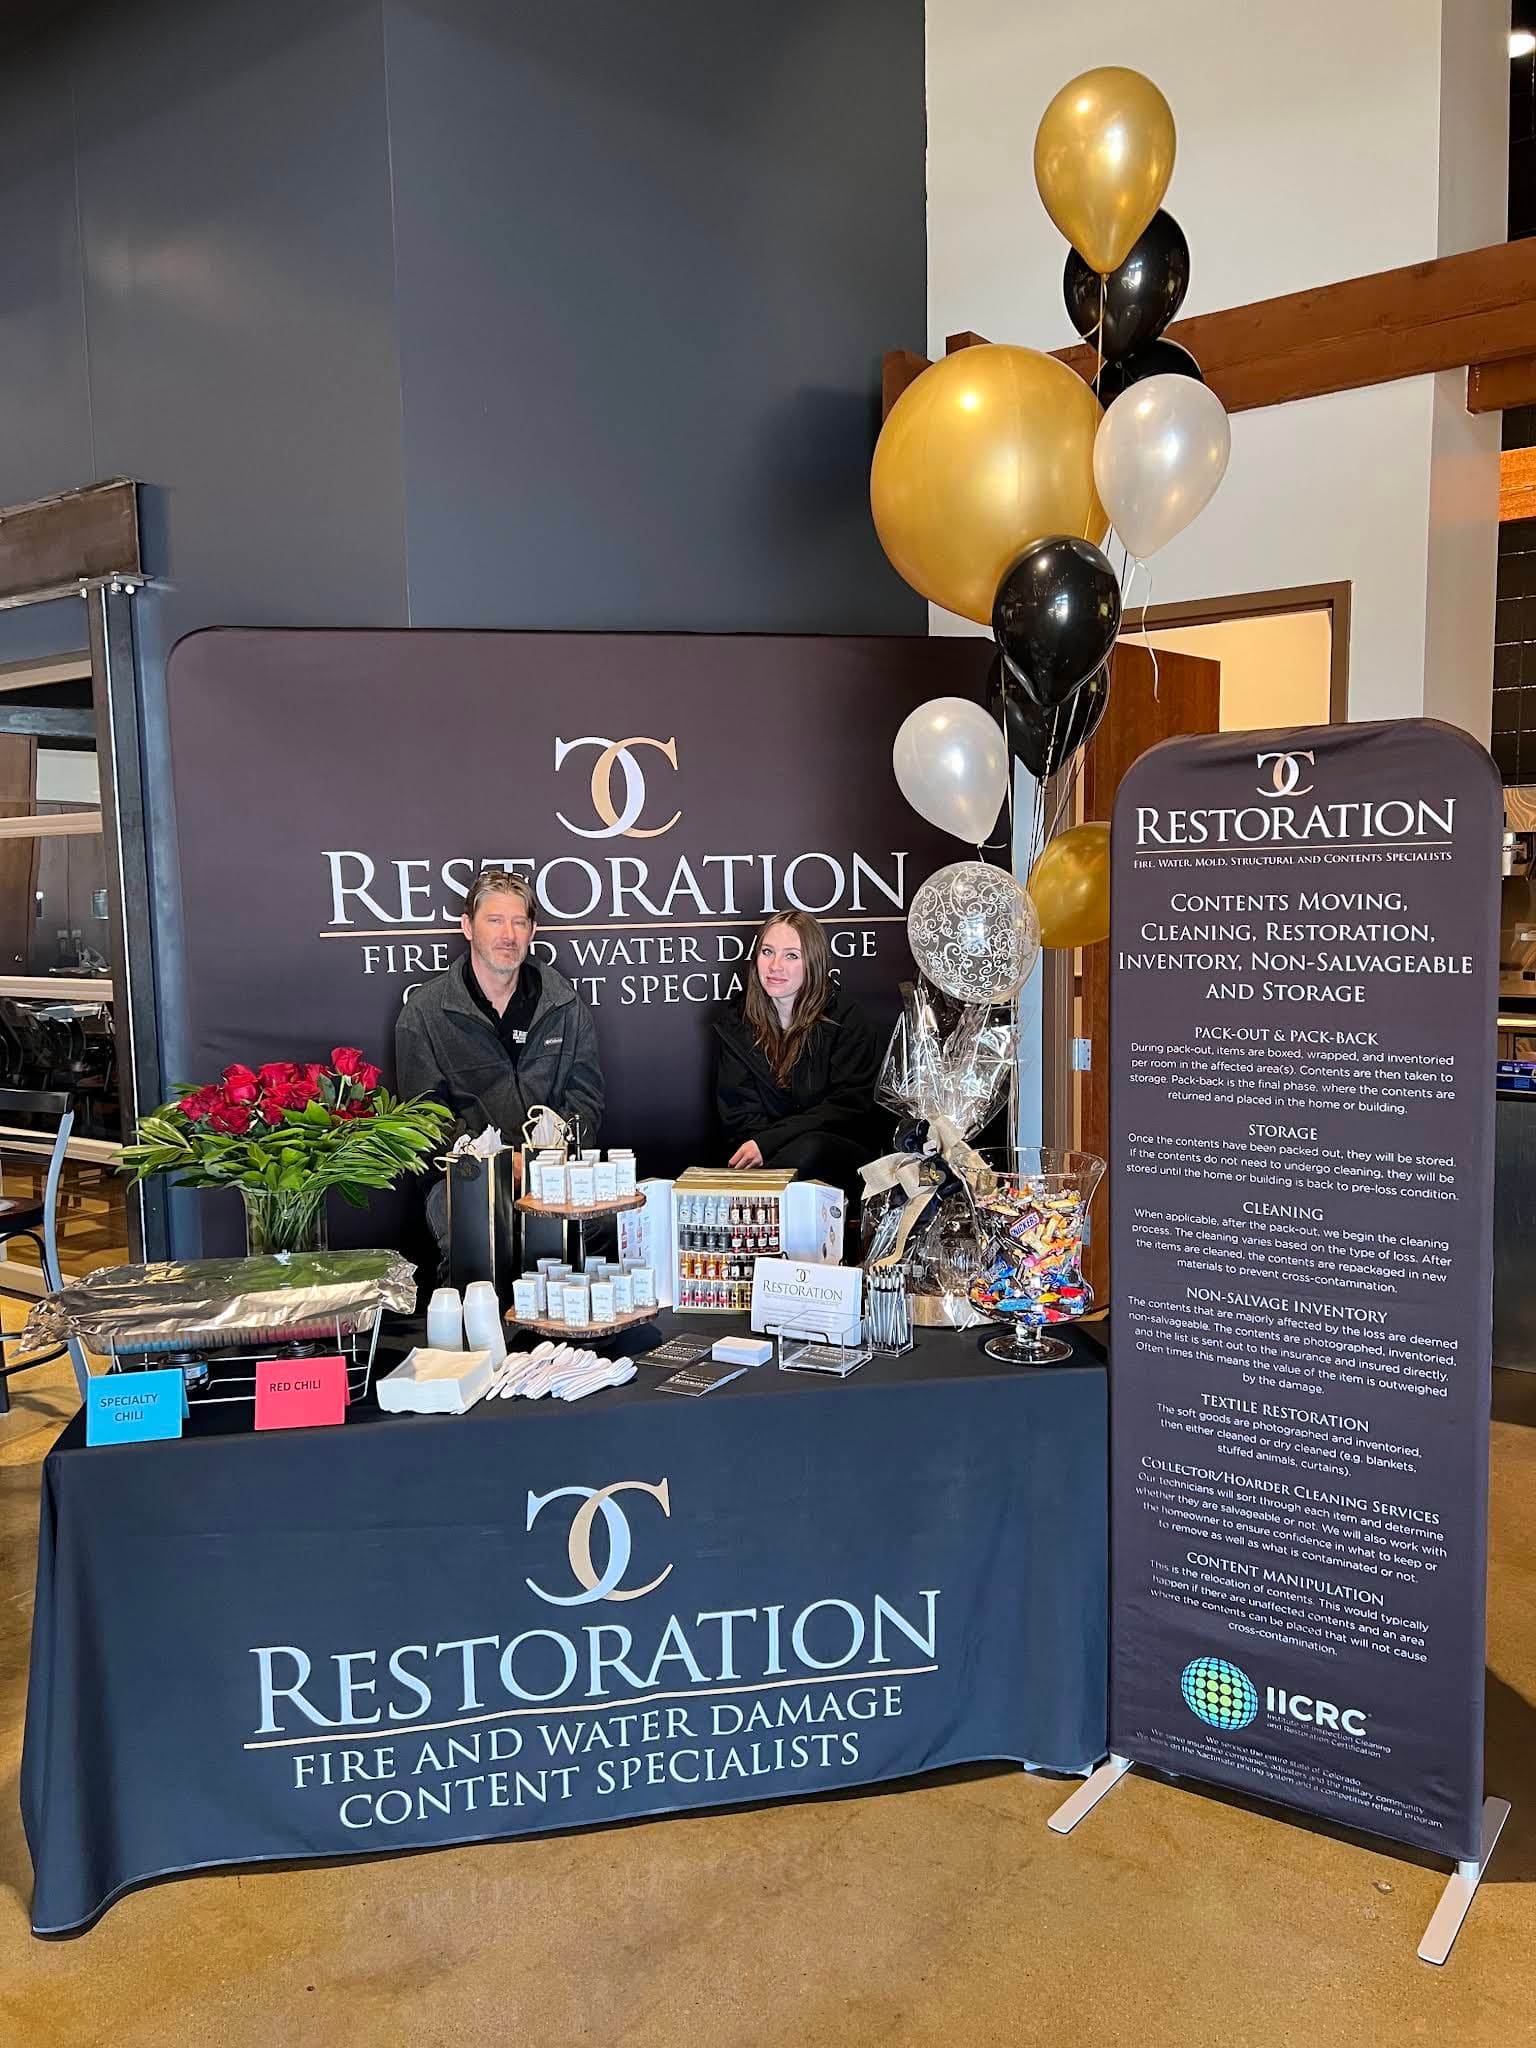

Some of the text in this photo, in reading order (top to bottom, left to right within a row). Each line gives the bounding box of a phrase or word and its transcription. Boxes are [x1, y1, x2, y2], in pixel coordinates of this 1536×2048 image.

[1136, 798, 1456, 845] RESTORATION
[1231, 856, 1294, 866] STRUCTURAL
[1298, 855, 1321, 864] AND
[1324, 853, 1383, 863] CONTENTS
[1386, 851, 1453, 862] SPECIALISTS
[1170, 892, 1409, 913] CONTENTS MOVING,
[1141, 922, 1435, 944] CLEANING, RESTORATION,
[361, 943, 450, 974] FIRE
[568, 936, 705, 966] WATER
[717, 931, 877, 962] DGE
[1118, 951, 1474, 975] INVENTORY, NON-SALVAGEABLE
[620, 968, 841, 1005] SPECIAS
[1205, 982, 1366, 1003] AND STORAGE
[1195, 1027, 1379, 1045] PACK-OUT & PACK-BACK
[1131, 1043, 1164, 1054] During
[1217, 1047, 1245, 1056] items
[1362, 1053, 1384, 1062] and
[1388, 1053, 1455, 1065] inventoried
[1171, 1075, 1224, 1087] Pack-back
[1227, 1079, 1235, 1087] is
[1238, 1079, 1255, 1088] the
[1258, 1080, 1281, 1089] final
[1322, 1083, 1357, 1094] where
[1359, 1085, 1379, 1095] the
[1381, 1087, 1433, 1098] contents
[1436, 1091, 1455, 1100] are
[1168, 1091, 1211, 1101] returned
[1214, 1093, 1234, 1102] and
[1237, 1094, 1272, 1105] placed
[1275, 1096, 1285, 1106] in
[1288, 1097, 1305, 1107] the
[1309, 1098, 1340, 1109] home
[1343, 1101, 1356, 1110] or
[1248, 1123, 1318, 1140] STORAGE
[1128, 1133, 1154, 1143] Once
[1157, 1135, 1173, 1145] the
[1175, 1138, 1220, 1149] contents
[1222, 1140, 1248, 1150] have
[1250, 1142, 1276, 1153] been
[1279, 1145, 1319, 1157] packed
[1347, 1150, 1372, 1162] they
[1375, 1152, 1394, 1162] will
[1397, 1153, 1412, 1163] be
[1243, 1202, 1324, 1221] CLEANING
[1134, 1208, 1163, 1220] When
[1221, 1217, 1246, 1228] after
[1249, 1220, 1267, 1231] the
[1323, 1229, 1340, 1239] we
[1343, 1230, 1375, 1243] begin
[1378, 1233, 1397, 1244] the
[1400, 1236, 1449, 1251] cleaning
[1177, 1258, 1223, 1272] materials
[1225, 1264, 1237, 1274] to
[1239, 1266, 1279, 1280] prevent
[763, 1279, 843, 1301] RESTORATION
[1187, 1287, 1388, 1324] NON-SALVAGE INVENTORY
[1214, 1323, 1233, 1334] The
[1235, 1327, 1281, 1341] contents
[1283, 1334, 1301, 1344] are
[269, 1379, 322, 1392] RED CHILI
[1242, 1372, 1256, 1385] by
[1258, 1375, 1276, 1387] the
[100, 1393, 158, 1408] SPECIALTY
[114, 1410, 144, 1422] CHILI
[1157, 1402, 1175, 1415] The
[1177, 1407, 1197, 1419] soft
[1199, 1412, 1231, 1425] goods
[1233, 1417, 1250, 1428] are
[1253, 1421, 1329, 1441] photographed
[1331, 1434, 1353, 1446] and
[1201, 1393, 1369, 1433] TEXTILE RESTORATION
[1217, 1444, 1253, 1458] stuffed
[1141, 1456, 1440, 1525] COLLECTOR/HOARDER CLEANING SERVICES
[1159, 1477, 1214, 1496] technicians
[1217, 1487, 1234, 1499] will
[1236, 1492, 1257, 1504] sort
[1259, 1497, 1301, 1513] through
[1304, 1505, 1331, 1519] each
[1333, 1511, 1358, 1524] item
[1360, 1516, 1382, 1529] and
[1385, 1522, 1444, 1541] determine
[1186, 1551, 1385, 1606] CONTENT MANIPULATION
[1171, 1564, 1179, 1574] is
[1182, 1567, 1198, 1579] the
[1200, 1573, 1251, 1591] relocation
[1253, 1583, 1265, 1593] of
[1318, 1598, 1341, 1611] This
[1344, 1605, 1378, 1620] would
[1380, 1613, 1430, 1633] typically
[249, 1590, 941, 1734] RESTORATION
[1266, 1686, 1367, 1737] IICRC
[292, 1685, 903, 1789] FIRE AND WATER DAMAGE
[339, 1731, 860, 1829] CONTENT SPECIALISTS
